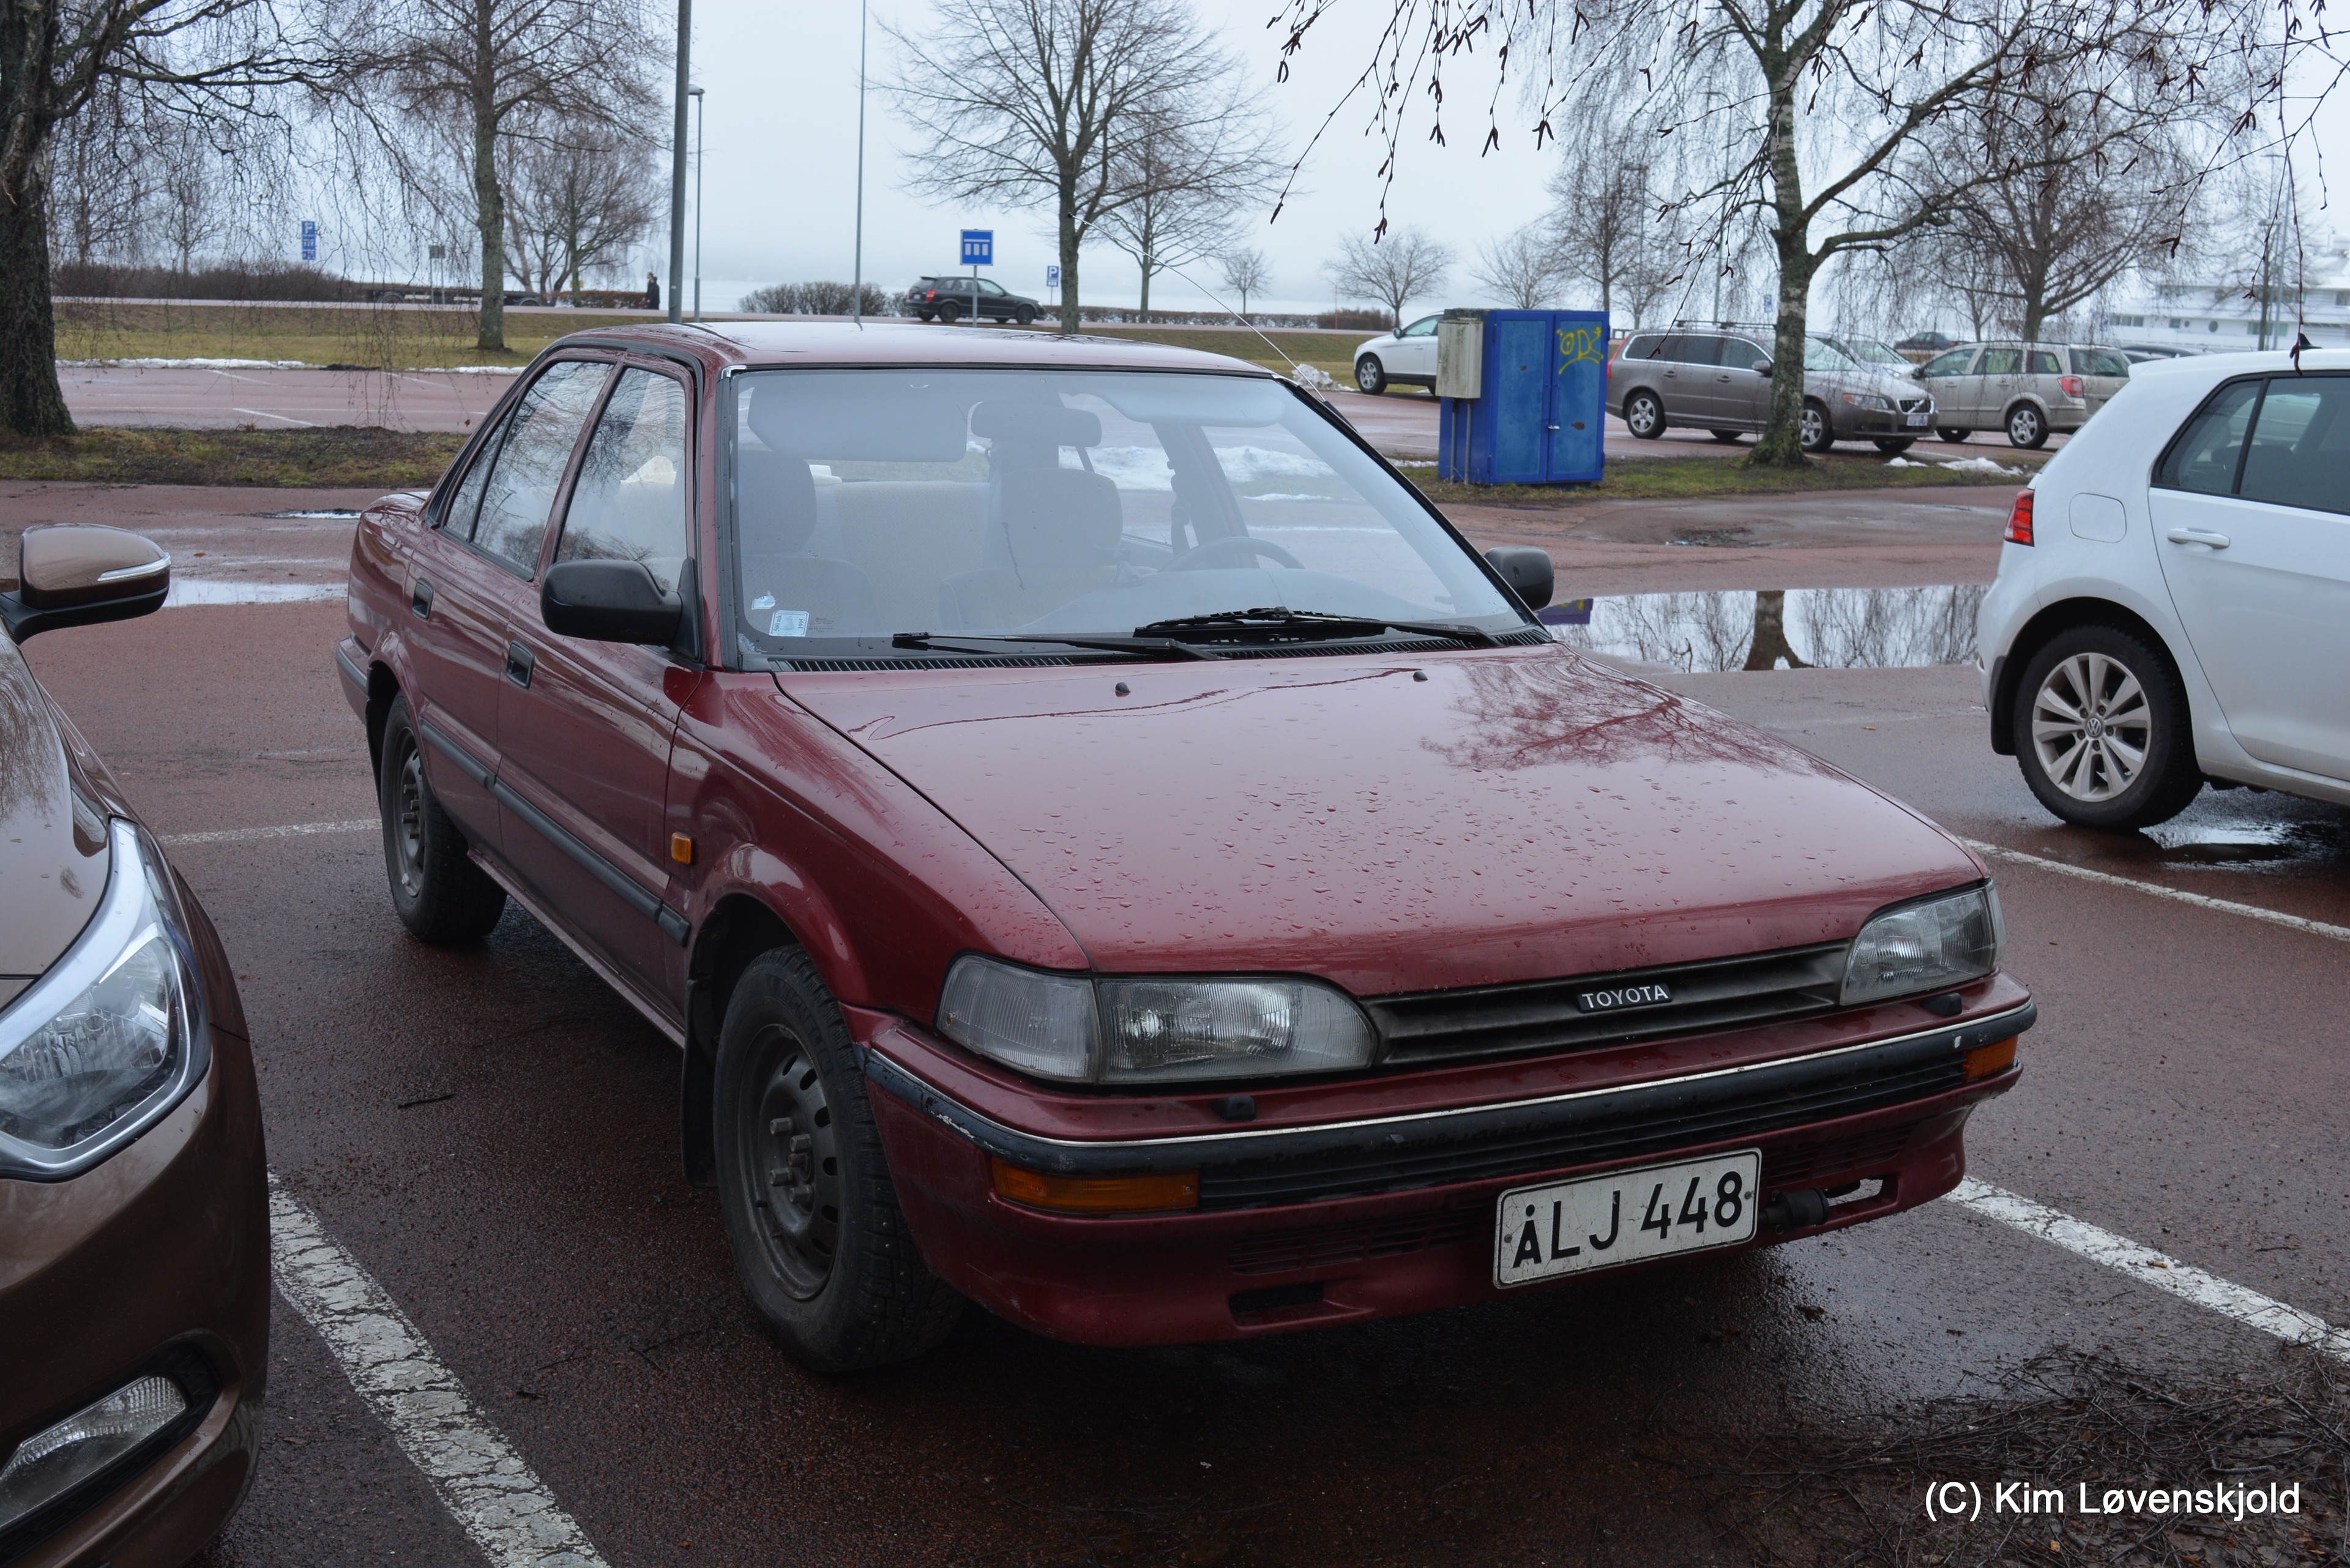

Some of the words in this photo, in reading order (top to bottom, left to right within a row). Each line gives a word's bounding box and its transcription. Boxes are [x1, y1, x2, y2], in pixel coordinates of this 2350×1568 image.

[305, 222, 314, 234] P
[1048, 267, 1058, 278] P
[1581, 985, 1669, 1009] TOYOTA
[776, 979, 834, 1072] MICHELIN
[1513, 1190, 1621, 1268] ÅLJ
[1641, 1171, 1744, 1239] 448
